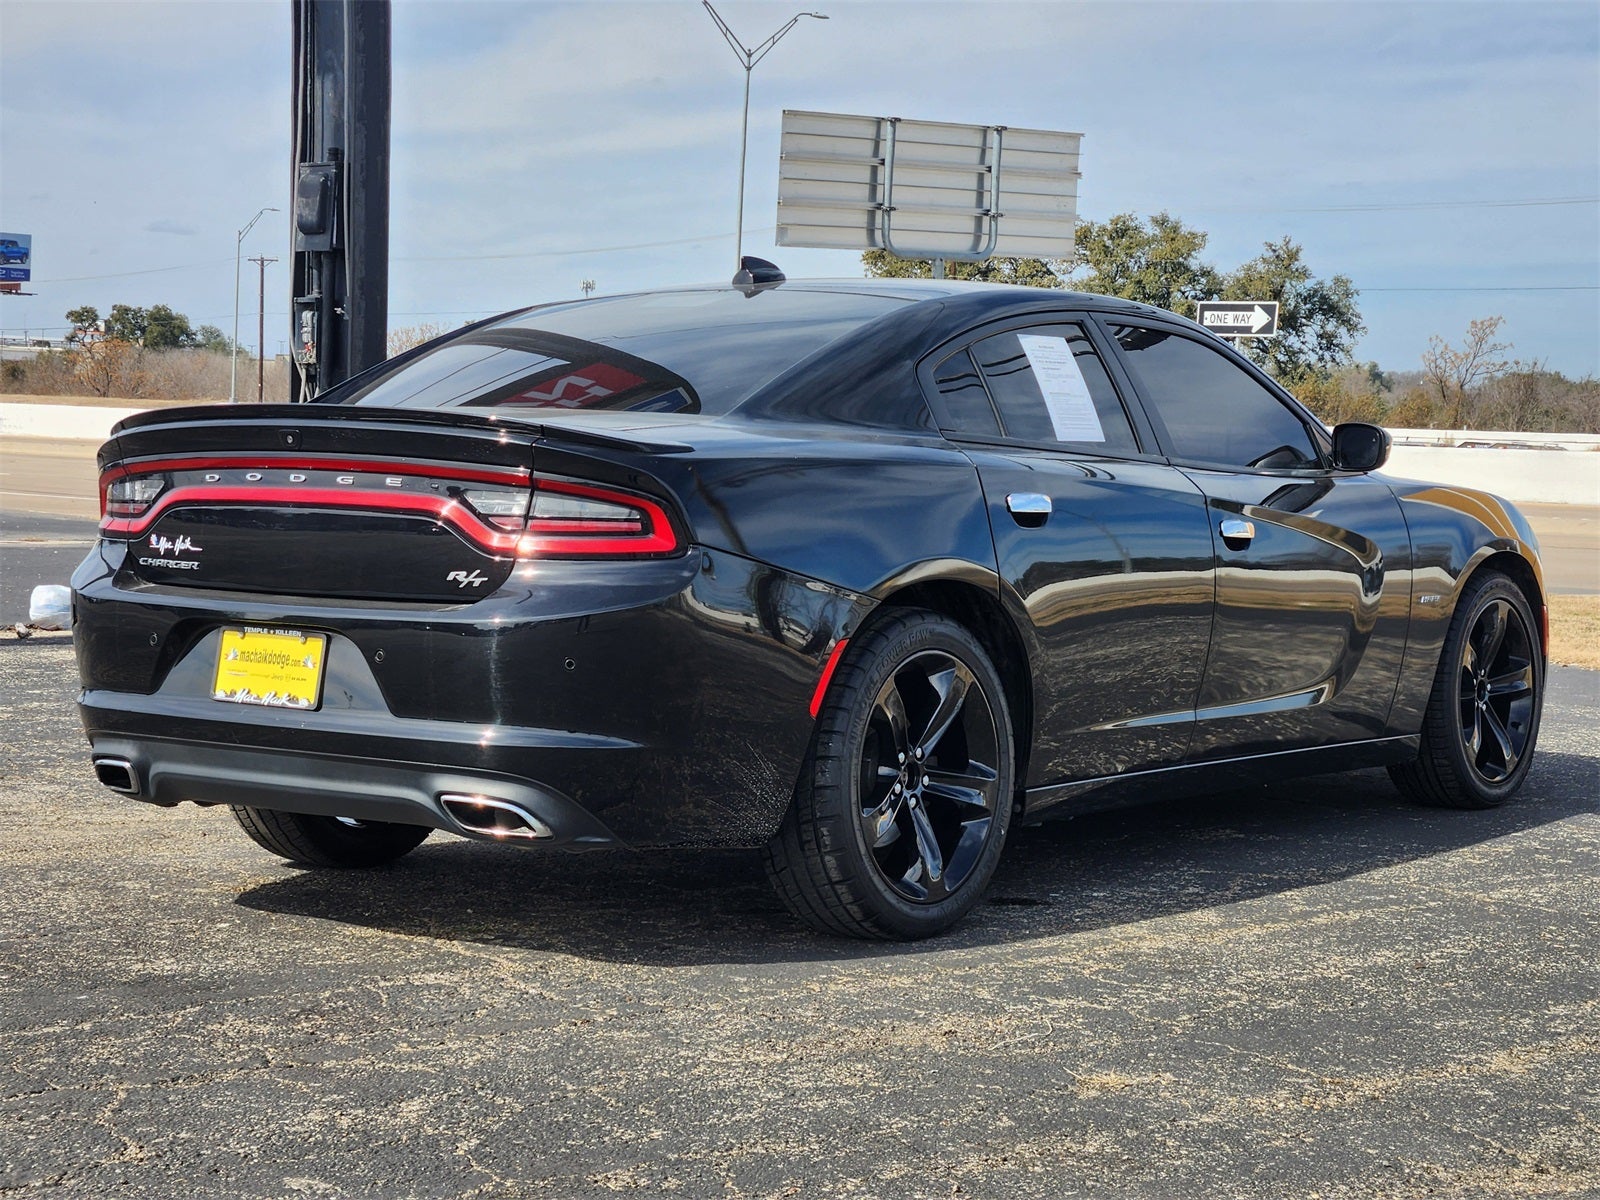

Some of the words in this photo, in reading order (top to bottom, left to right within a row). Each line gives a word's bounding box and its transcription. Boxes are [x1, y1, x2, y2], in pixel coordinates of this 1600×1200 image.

[1209, 313, 1229, 324] ONE
[1232, 313, 1252, 324] WAY
[205, 473, 403, 487] DODGE
[139, 557, 200, 570] CHARGER
[446, 569, 488, 588] R/T
[244, 626, 268, 634] TEMPLE
[275, 629, 301, 637] KILLEEN
[240, 649, 301, 669] machaikdodge.com
[234, 688, 259, 704] Mac
[260, 691, 299, 707] Haik
